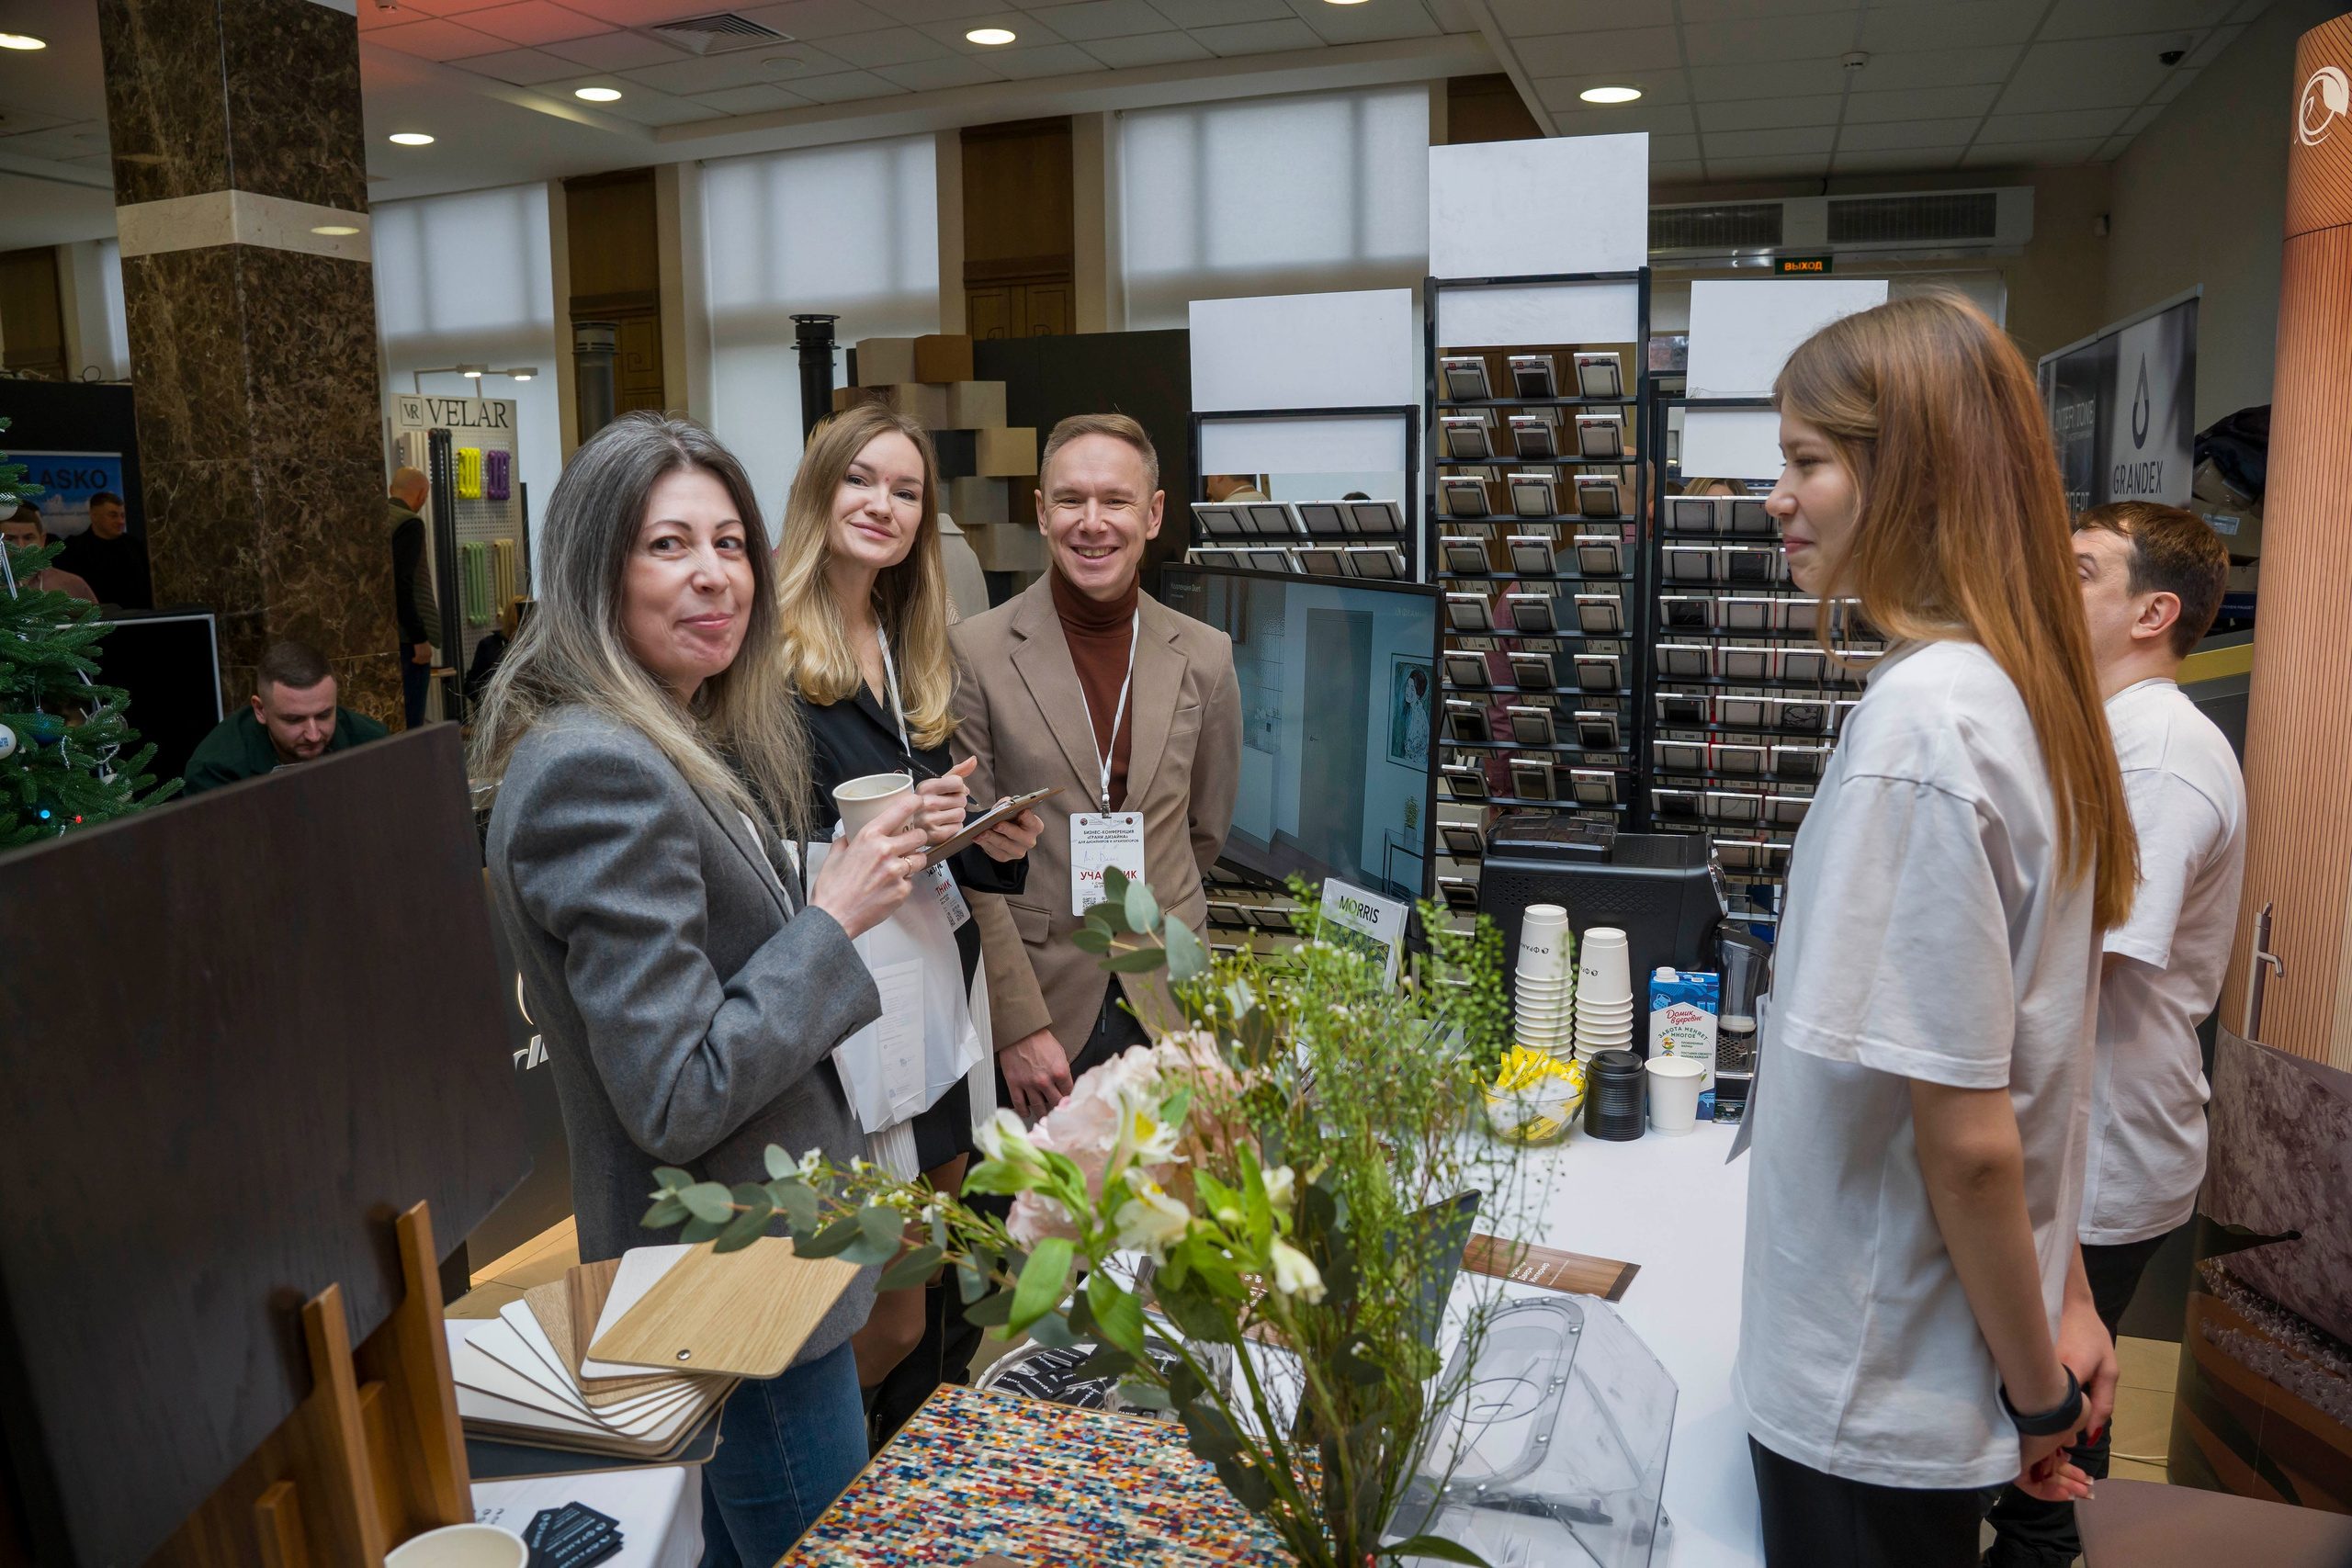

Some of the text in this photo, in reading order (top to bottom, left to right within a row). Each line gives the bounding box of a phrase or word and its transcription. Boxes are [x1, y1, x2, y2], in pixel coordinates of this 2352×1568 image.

[1784, 261, 1823, 272] ВЫХОД
[425, 398, 509, 428] VELAR
[40, 468, 107, 490] ASKO
[2113, 460, 2164, 495] GRANDEX
[1080, 870, 1137, 880] УЧАИК
[1339, 896, 1380, 924] MORRIS
[1666, 1009, 1694, 1020] Домик
[1675, 1015, 1703, 1026] деревне
[1657, 1026, 1709, 1041] ЗАБОТА МЕНЯЕТ
